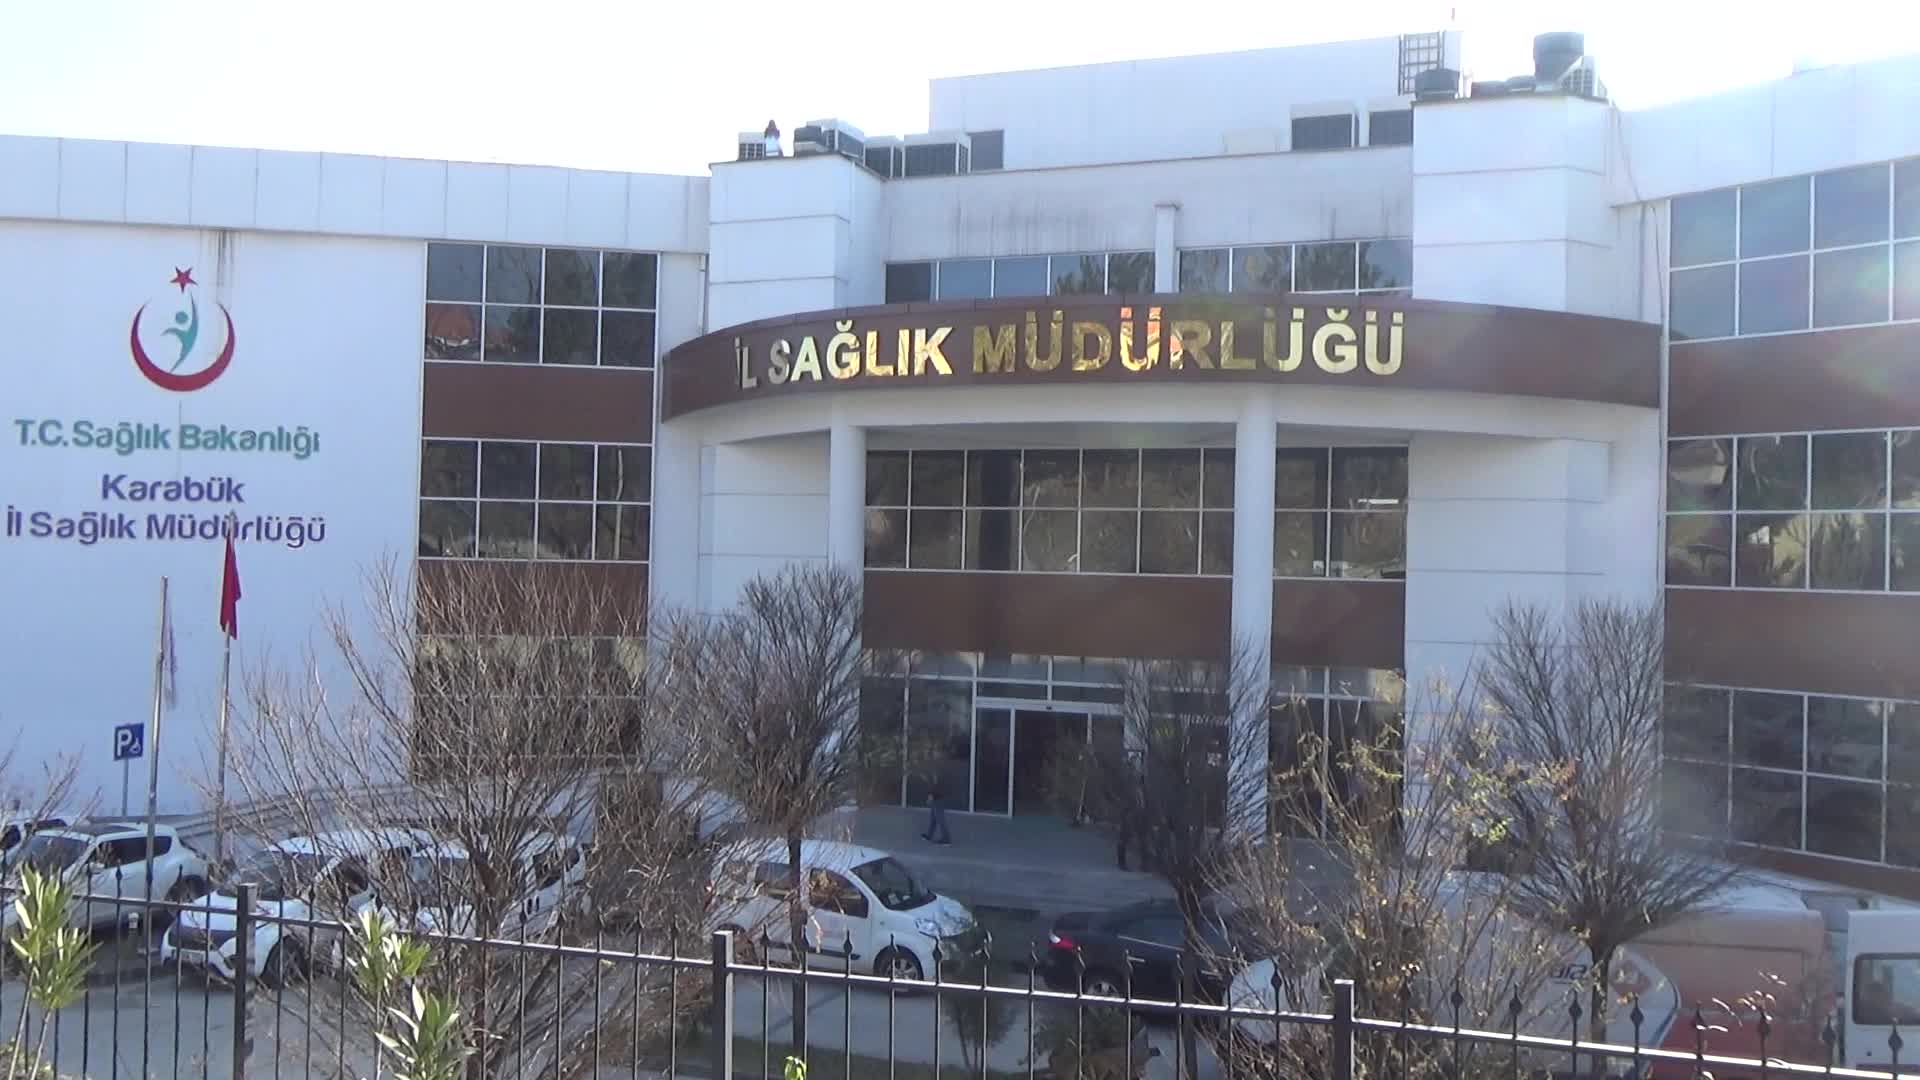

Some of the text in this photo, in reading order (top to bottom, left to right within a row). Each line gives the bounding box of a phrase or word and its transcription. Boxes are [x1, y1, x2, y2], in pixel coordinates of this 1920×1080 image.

[735, 307, 1404, 389] İL SAĞLIK MÜDÜRLÜĞÜ
[179, 423, 320, 460] Bakanlığı
[102, 474, 244, 503] Karabük
[7, 506, 325, 548] İl Sağlık Müdürlüğü
[117, 729, 132, 757] P
